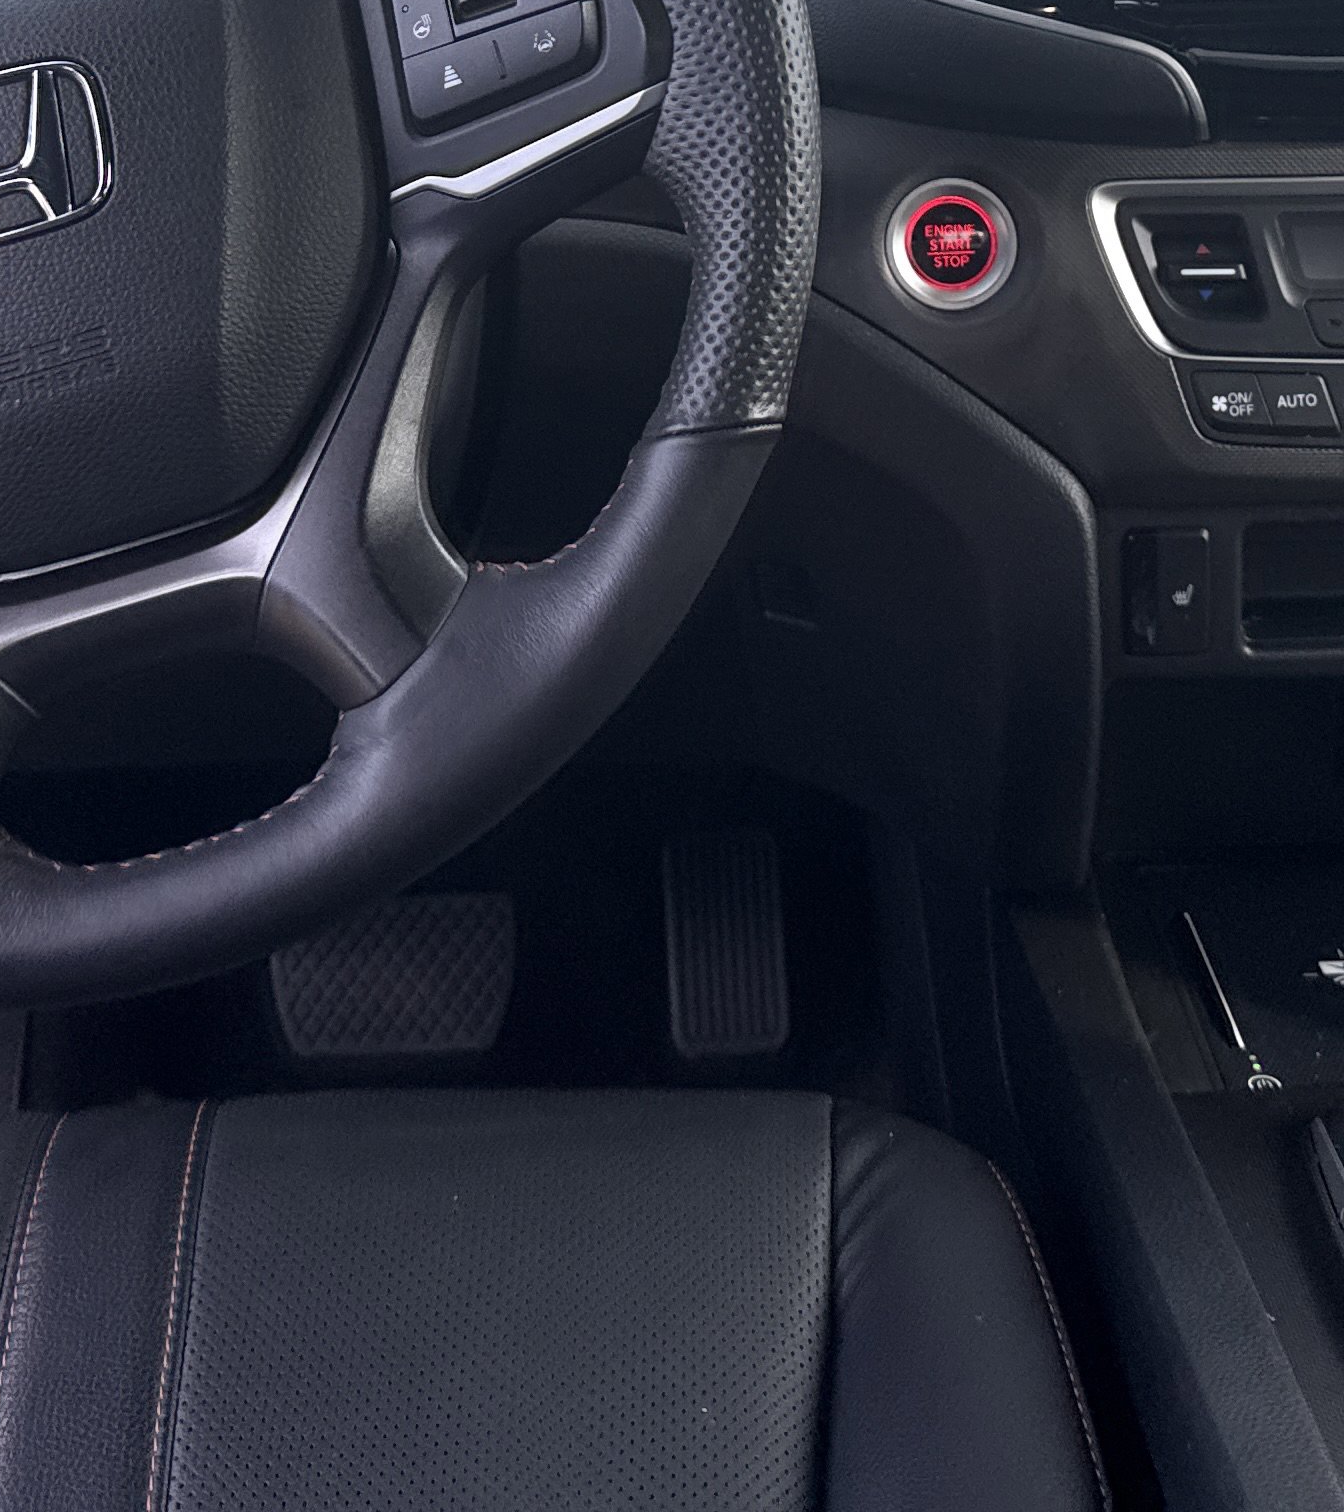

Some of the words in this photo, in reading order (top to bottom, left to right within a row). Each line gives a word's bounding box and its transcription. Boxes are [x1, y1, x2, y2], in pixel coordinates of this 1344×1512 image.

[924, 223, 976, 237] ENGINE
[929, 238, 972, 251] START
[933, 255, 970, 268] STOP
[1277, 393, 1318, 408] AUTO
[1229, 404, 1254, 416] OFF
